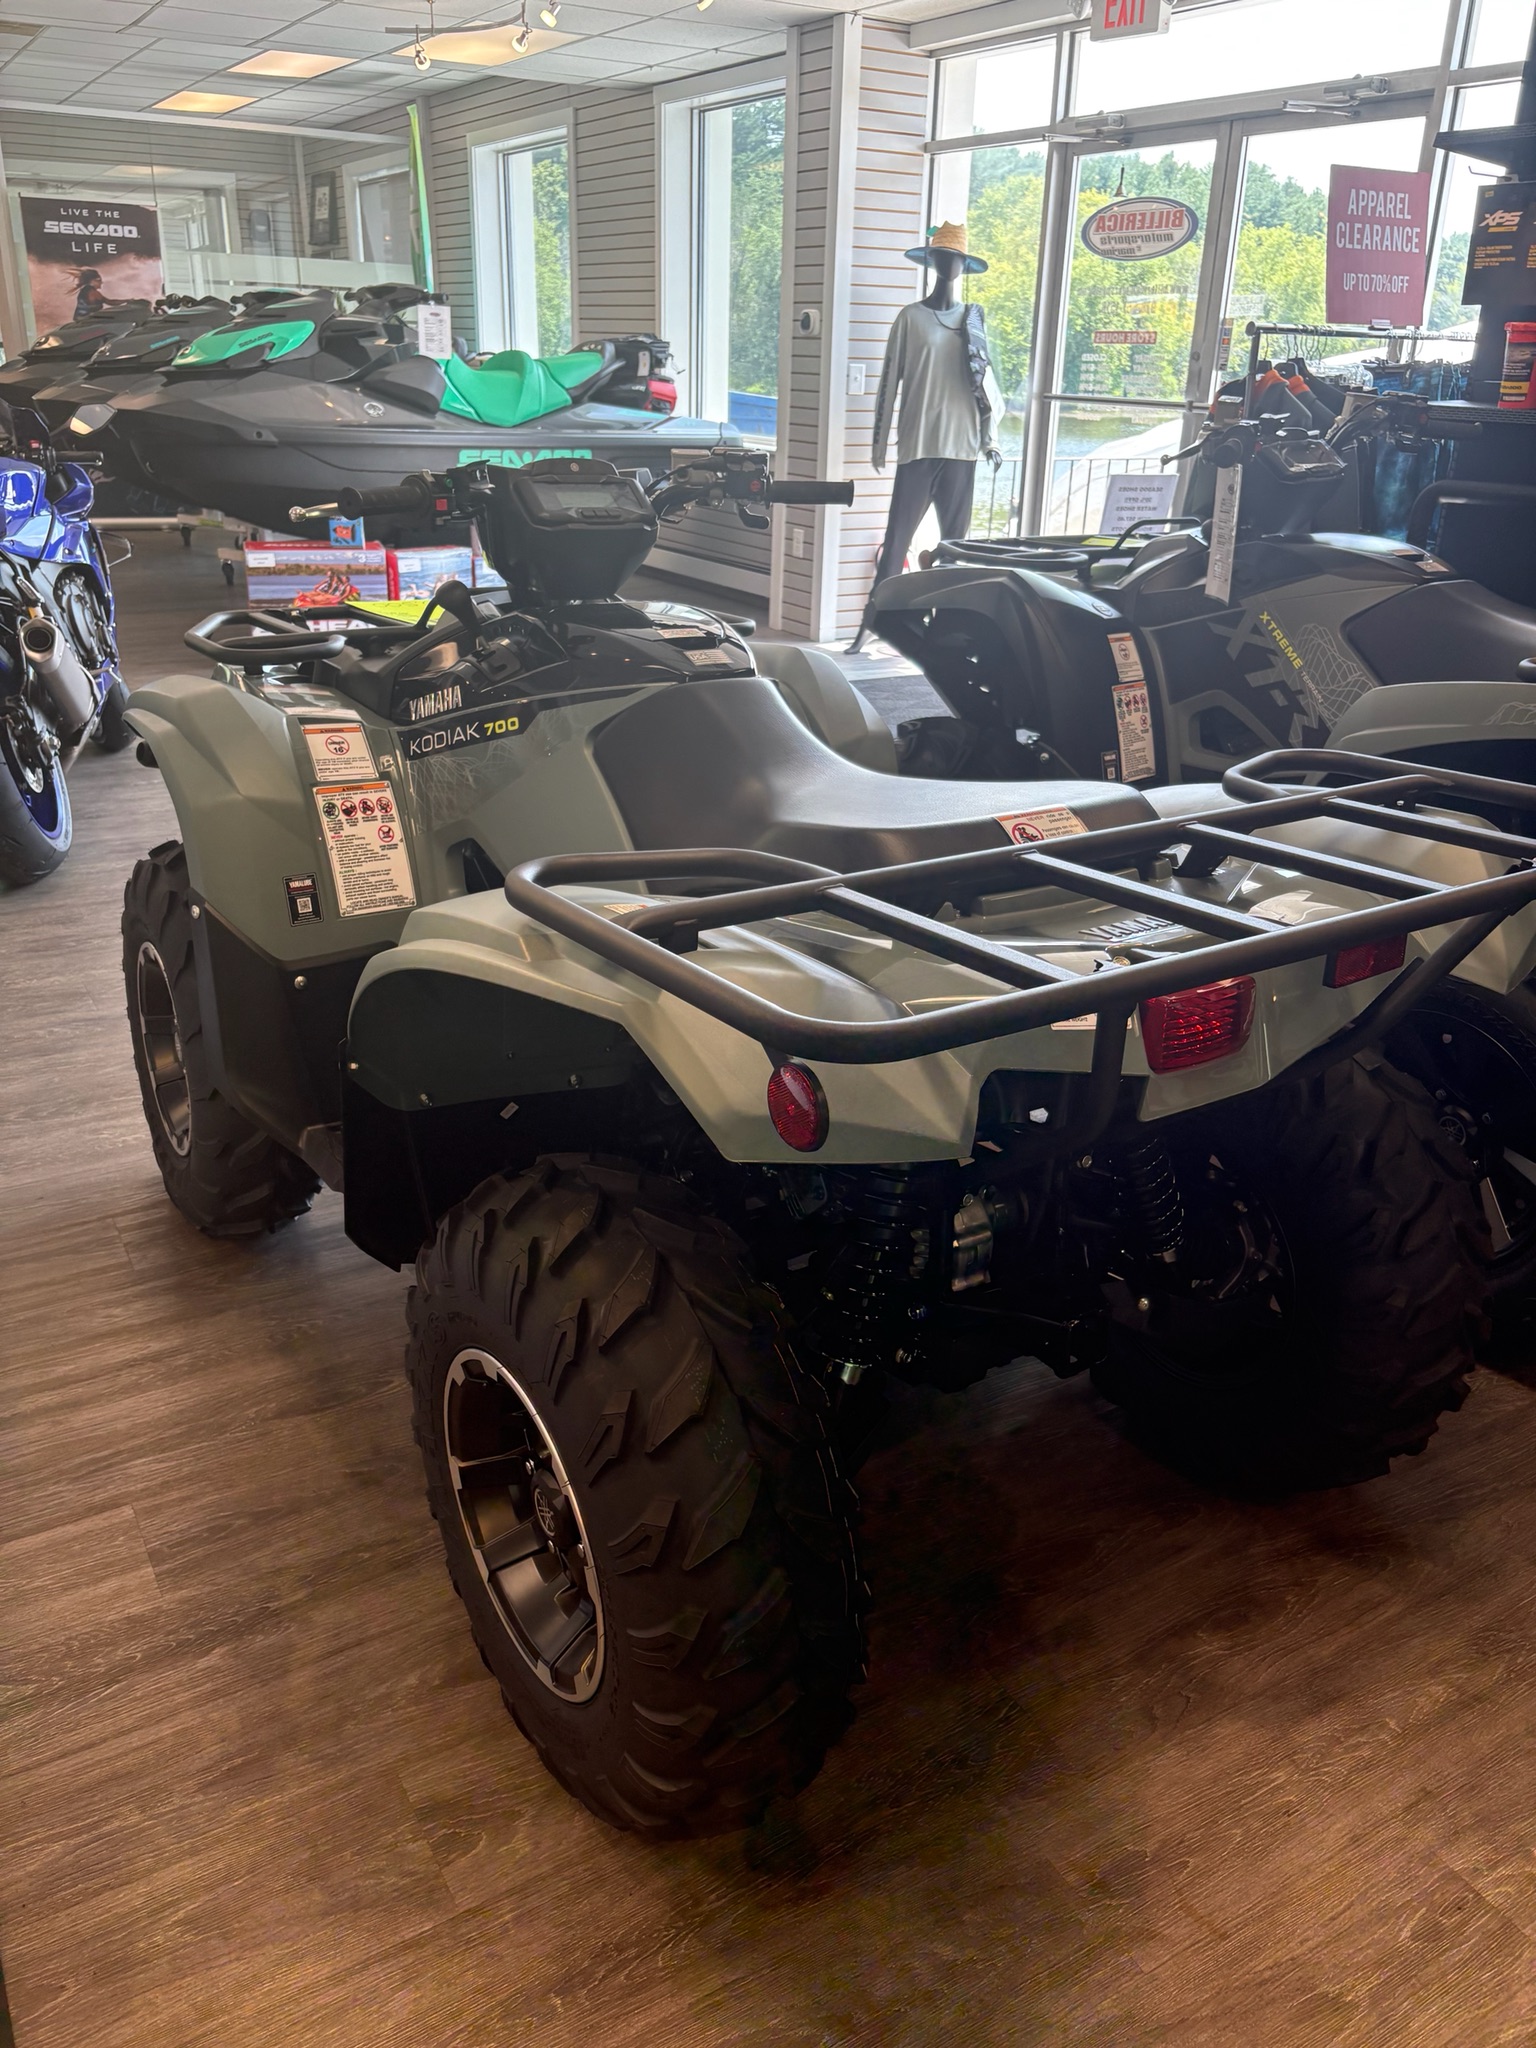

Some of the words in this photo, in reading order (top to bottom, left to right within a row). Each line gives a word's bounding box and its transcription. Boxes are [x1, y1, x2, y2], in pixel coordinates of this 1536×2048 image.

[60, 207, 89, 217] LIVE
[95, 209, 121, 219] THE
[1347, 188, 1412, 220] APPAREL
[1478, 209, 1523, 227] XPS
[71, 241, 118, 255] LIFE
[1335, 221, 1421, 254] CLEARANCE
[1343, 272, 1357, 291] UP
[1357, 274, 1370, 292] TO
[1370, 274, 1391, 293] 70%
[1391, 275, 1410, 294] OFF
[1258, 610, 1304, 670] XTREME
[409, 684, 463, 721] YAMAHA
[1301, 671, 1324, 703] TERRAIN
[410, 721, 480, 756] KODIAK
[483, 717, 520, 737] 700
